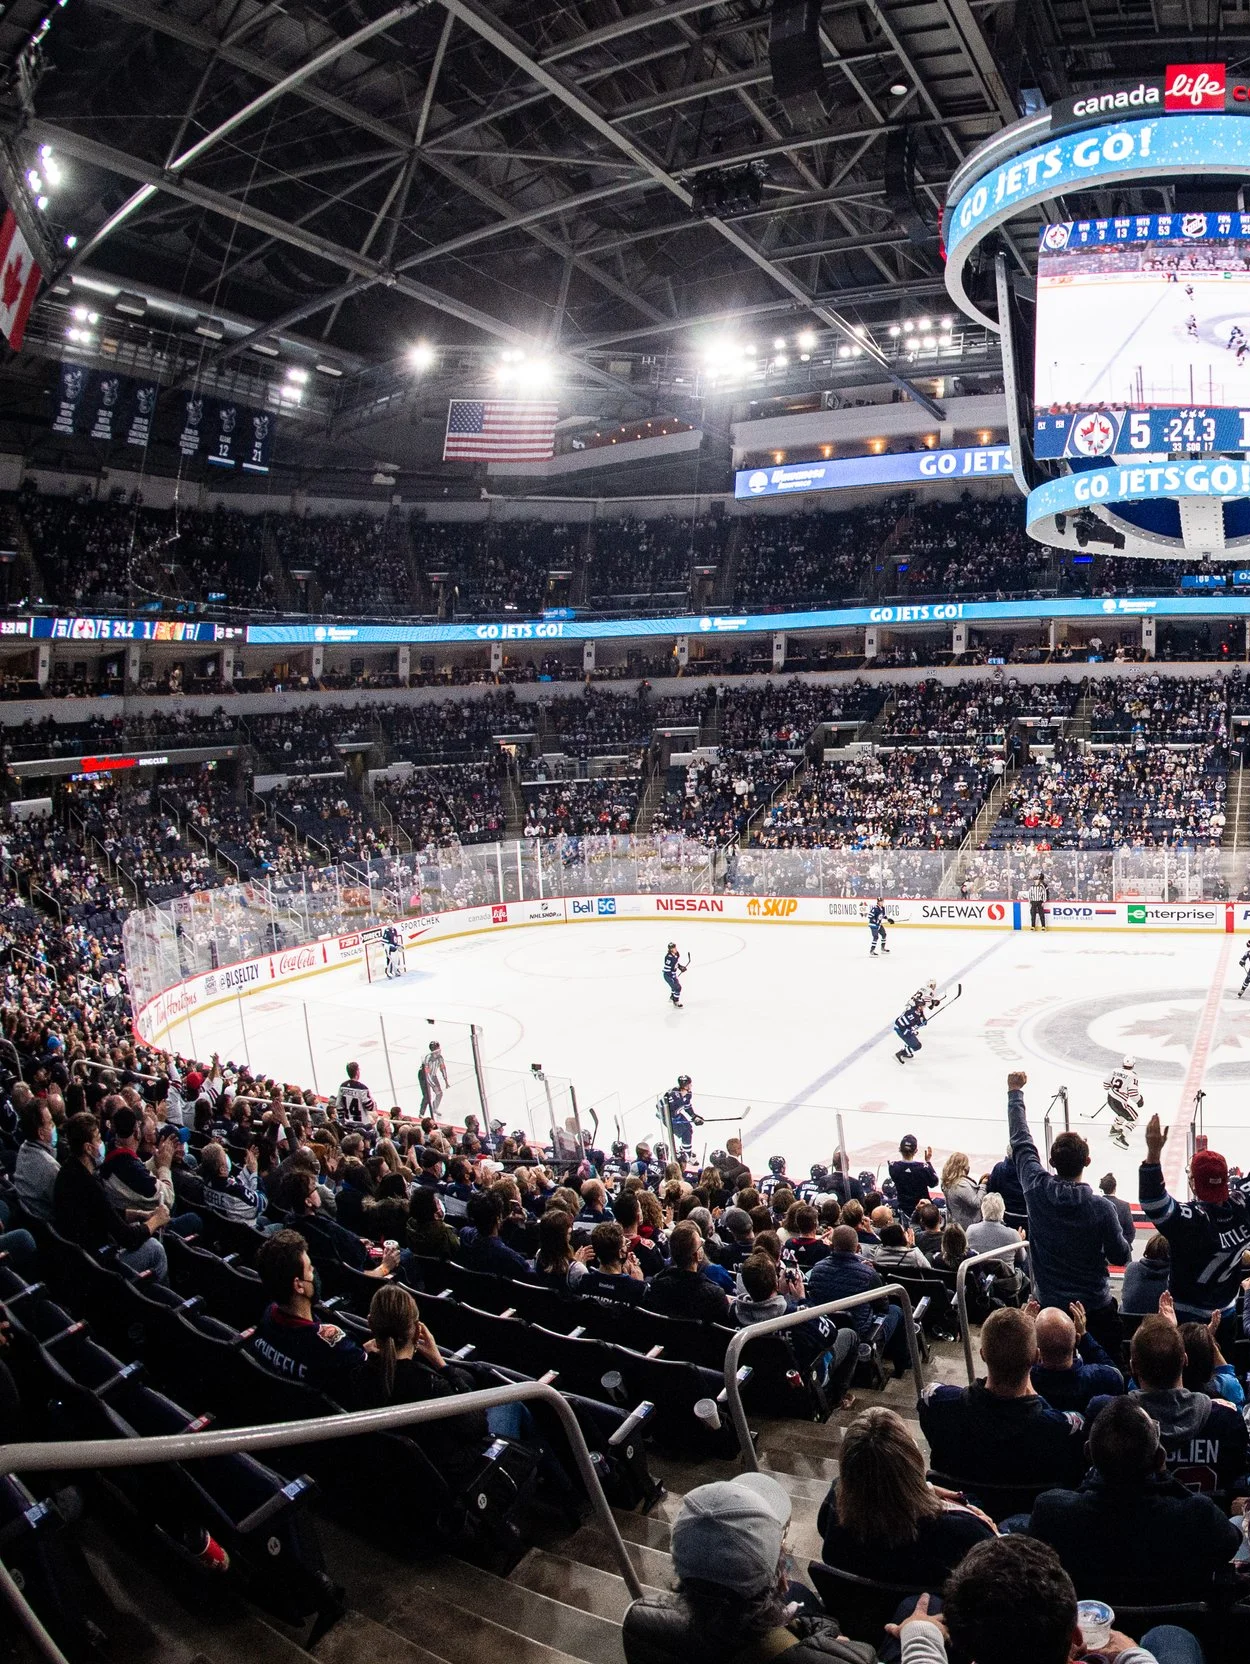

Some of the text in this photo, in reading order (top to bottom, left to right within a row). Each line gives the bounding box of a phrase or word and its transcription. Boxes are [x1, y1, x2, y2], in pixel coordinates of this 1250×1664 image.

[1072, 84, 1160, 117] canada
[1165, 73, 1225, 106] life
[960, 127, 1152, 229] GO JETS GO!
[1117, 228, 1128, 239] 13
[1136, 226, 1148, 237] 24
[1158, 225, 1170, 236] 53
[1219, 223, 1230, 234] 47
[1130, 413, 1150, 449] 5
[1163, 418, 1216, 443] :24.3
[1172, 442, 1182, 451] 33
[1203, 442, 1213, 451] 17
[919, 450, 1014, 476] GO JETS
[1074, 464, 1250, 501] GO JETS GO!
[870, 603, 963, 623] GO JETS GO!
[102, 620, 110, 638] 5
[144, 622, 151, 639] 1
[477, 623, 563, 639] GO JETS GO!
[572, 899, 594, 914] Bell
[598, 899, 616, 913] 5G
[656, 898, 724, 913] NISSAN
[762, 899, 798, 917] SKIP
[829, 903, 857, 915] CASINOS
[922, 905, 983, 919] SAFEWAY
[1053, 907, 1093, 916] BOYD
[468, 912, 491, 923] canada
[1133, 908, 1215, 923] enterprise
